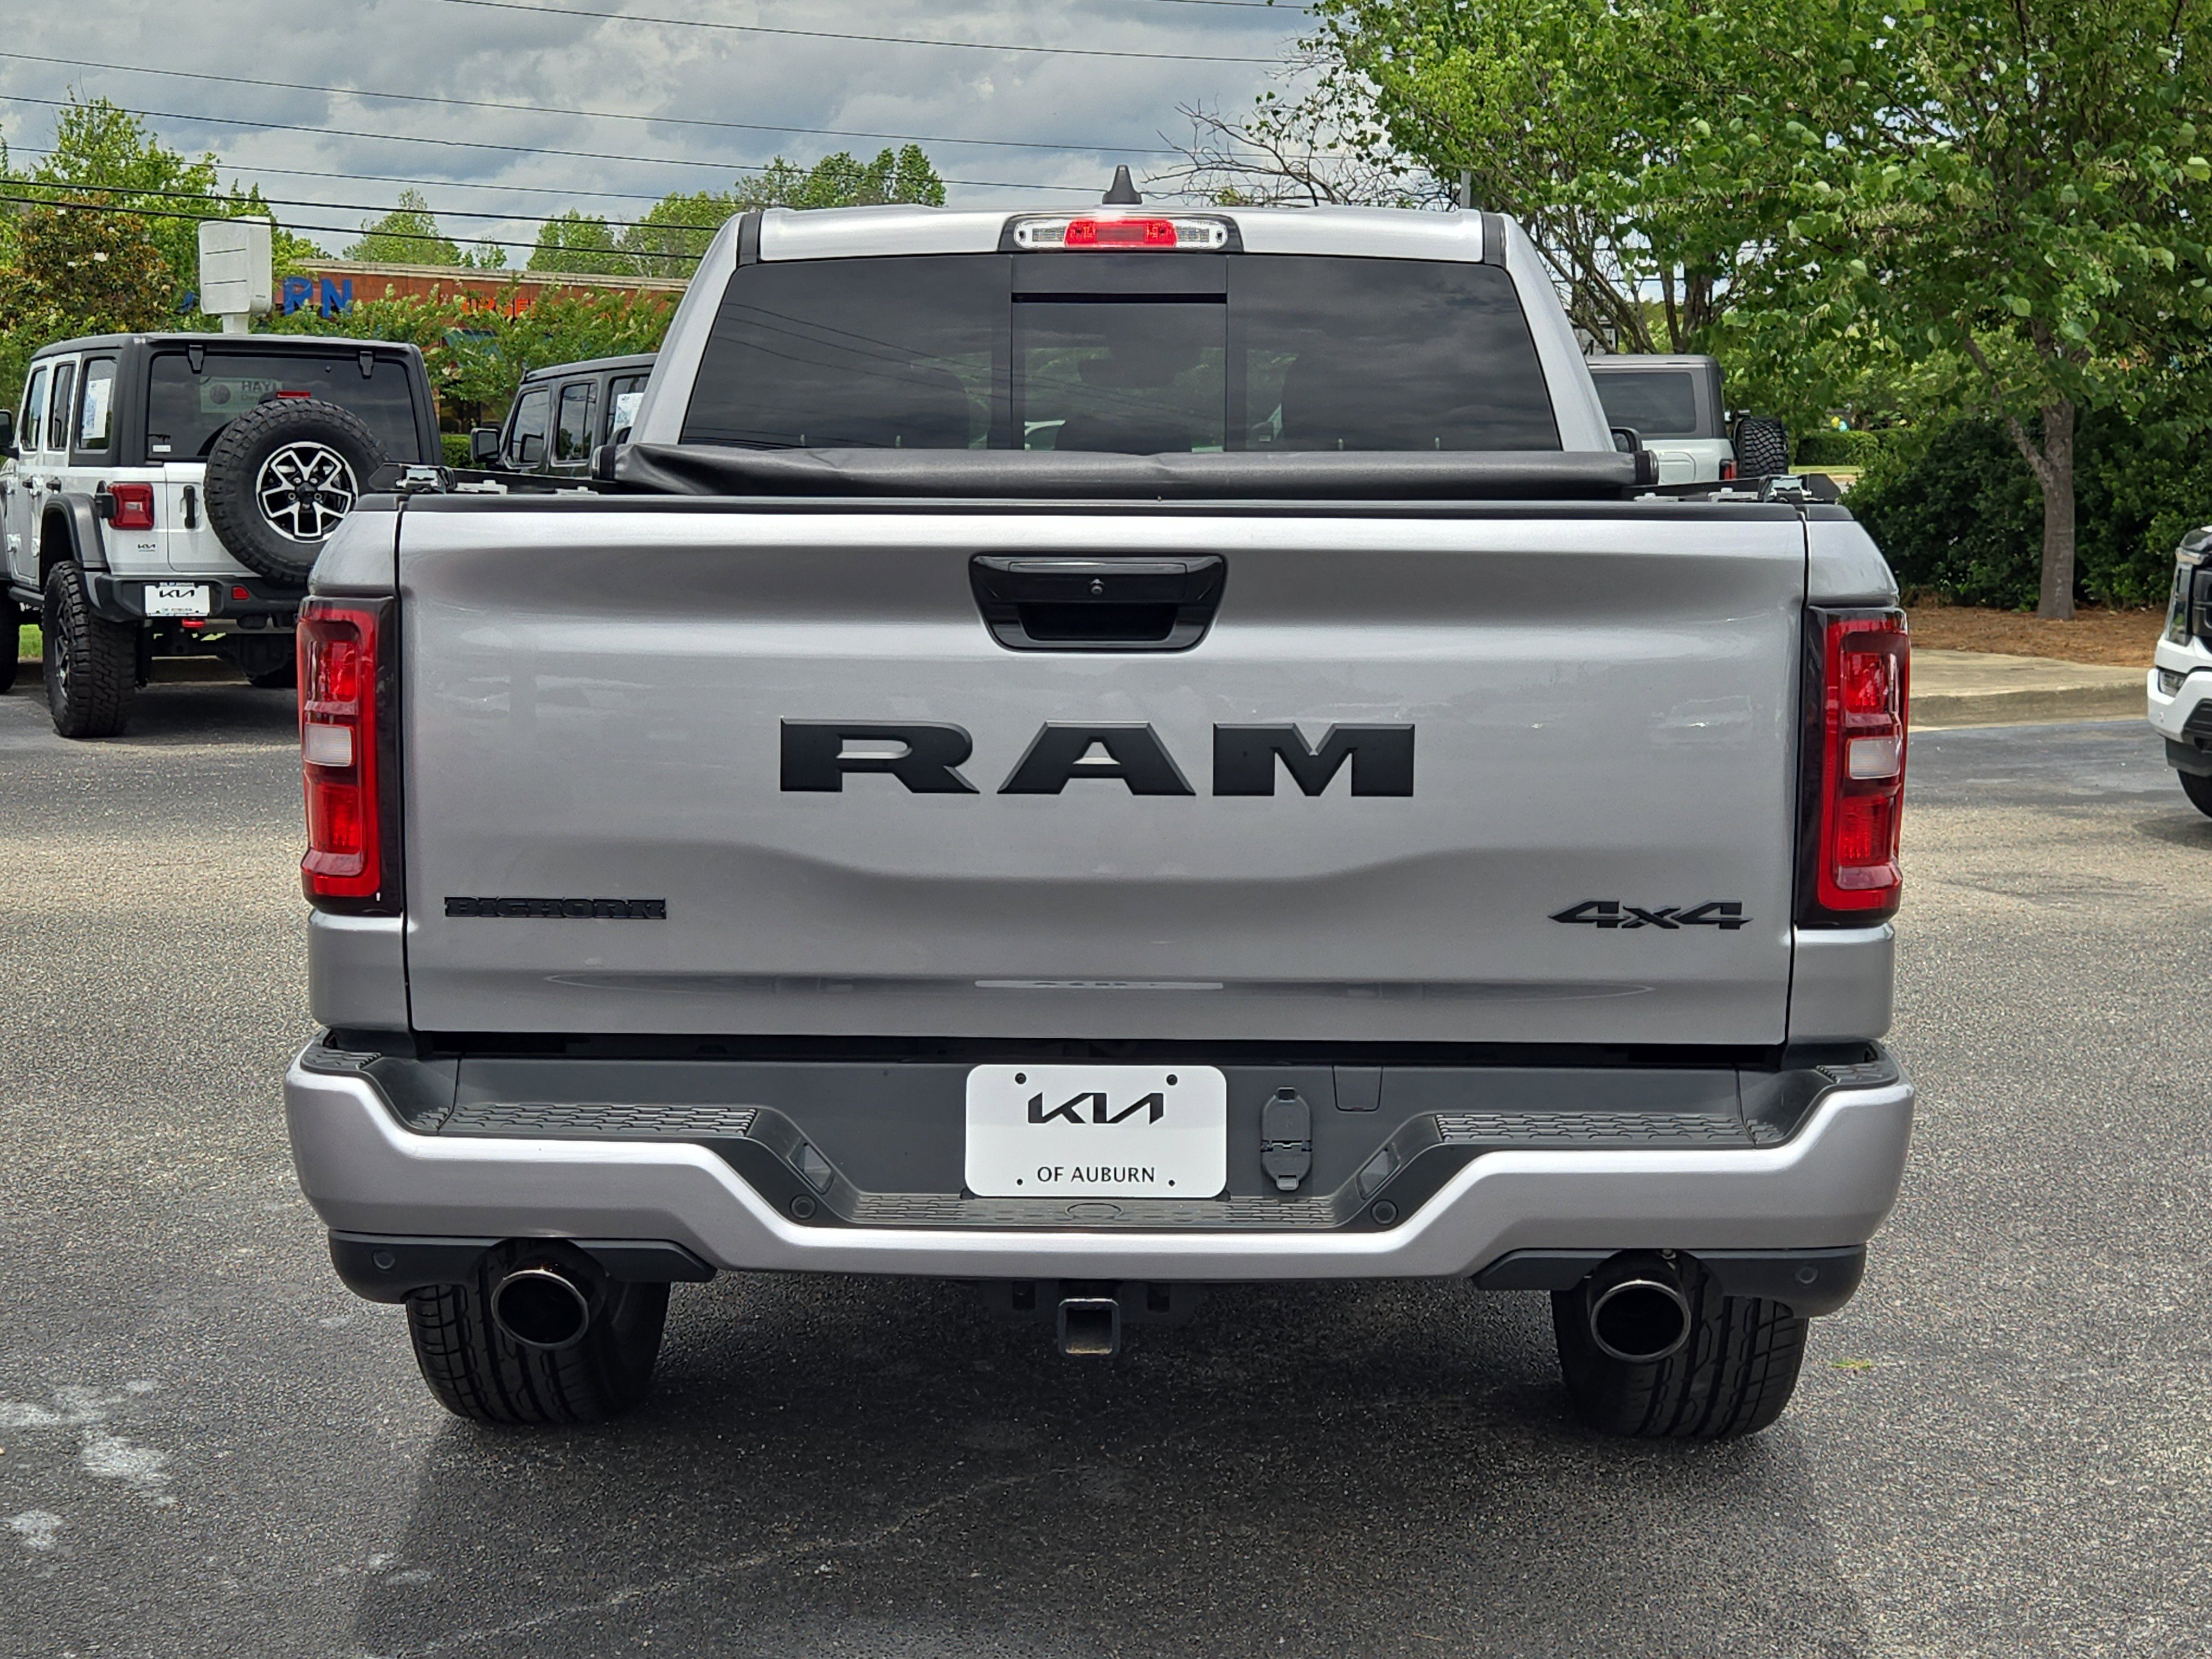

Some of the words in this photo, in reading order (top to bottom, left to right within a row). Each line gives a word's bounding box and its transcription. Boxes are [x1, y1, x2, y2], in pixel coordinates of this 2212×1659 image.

[159, 589, 195, 598] KIA
[780, 716, 1415, 797] RAM
[1028, 1092, 1164, 1124] KIA
[1037, 1166, 1064, 1182] OF
[1070, 1166, 1155, 1183] AUBURN
